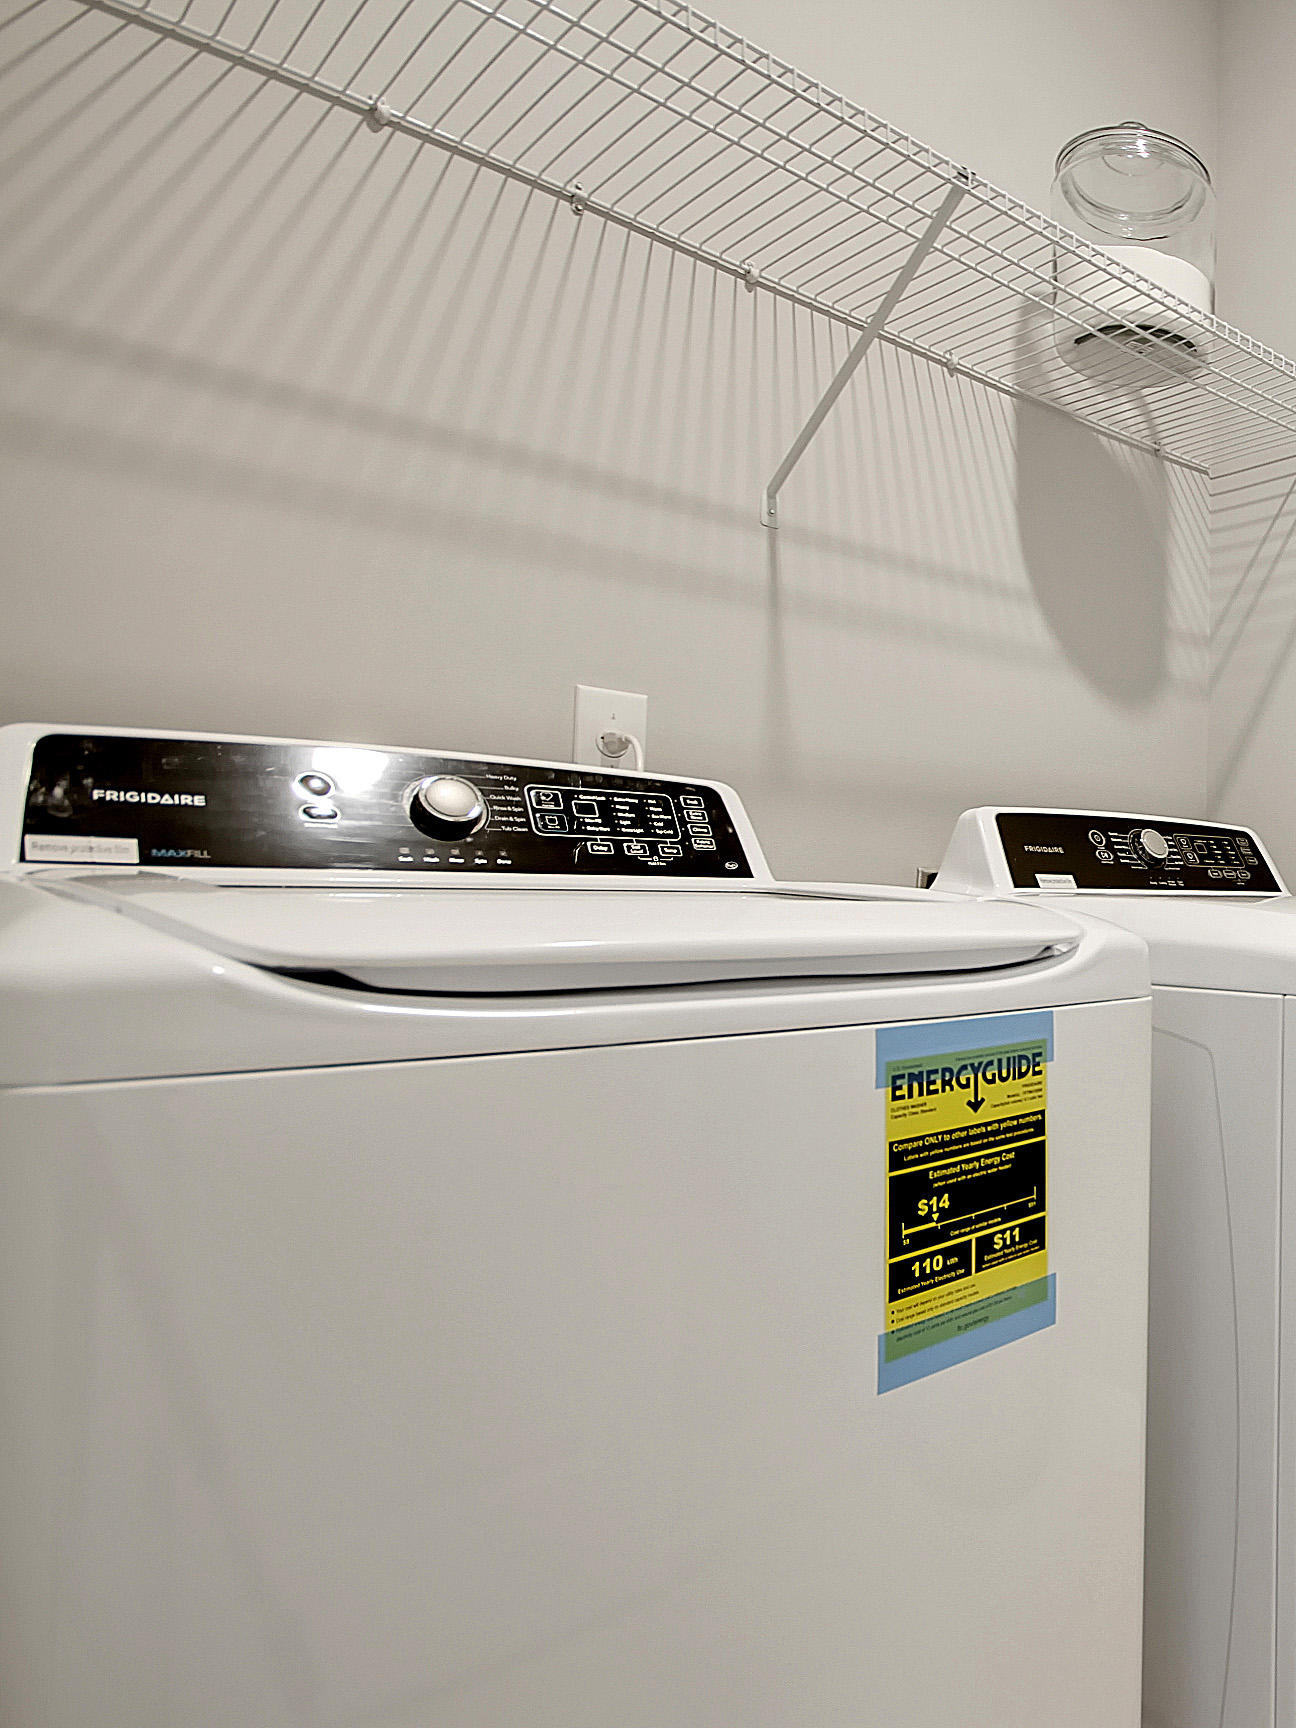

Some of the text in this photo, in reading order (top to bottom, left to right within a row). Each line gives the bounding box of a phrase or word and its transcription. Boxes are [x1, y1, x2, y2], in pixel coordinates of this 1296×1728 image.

[92, 789, 206, 806] FRIGIDAIRE
[1024, 845, 1065, 854] FRIGIDAIRE
[890, 1051, 1043, 1102] ENERGYGUIDE
[892, 1140, 923, 1152] Compare
[924, 1134, 942, 1146] ONLY
[943, 1134, 951, 1142] to
[928, 1151, 1016, 1179] Estimated Yearly Energy Cost
[917, 1193, 950, 1216] $14
[993, 1227, 1020, 1250] $11
[911, 1254, 944, 1278] 110
